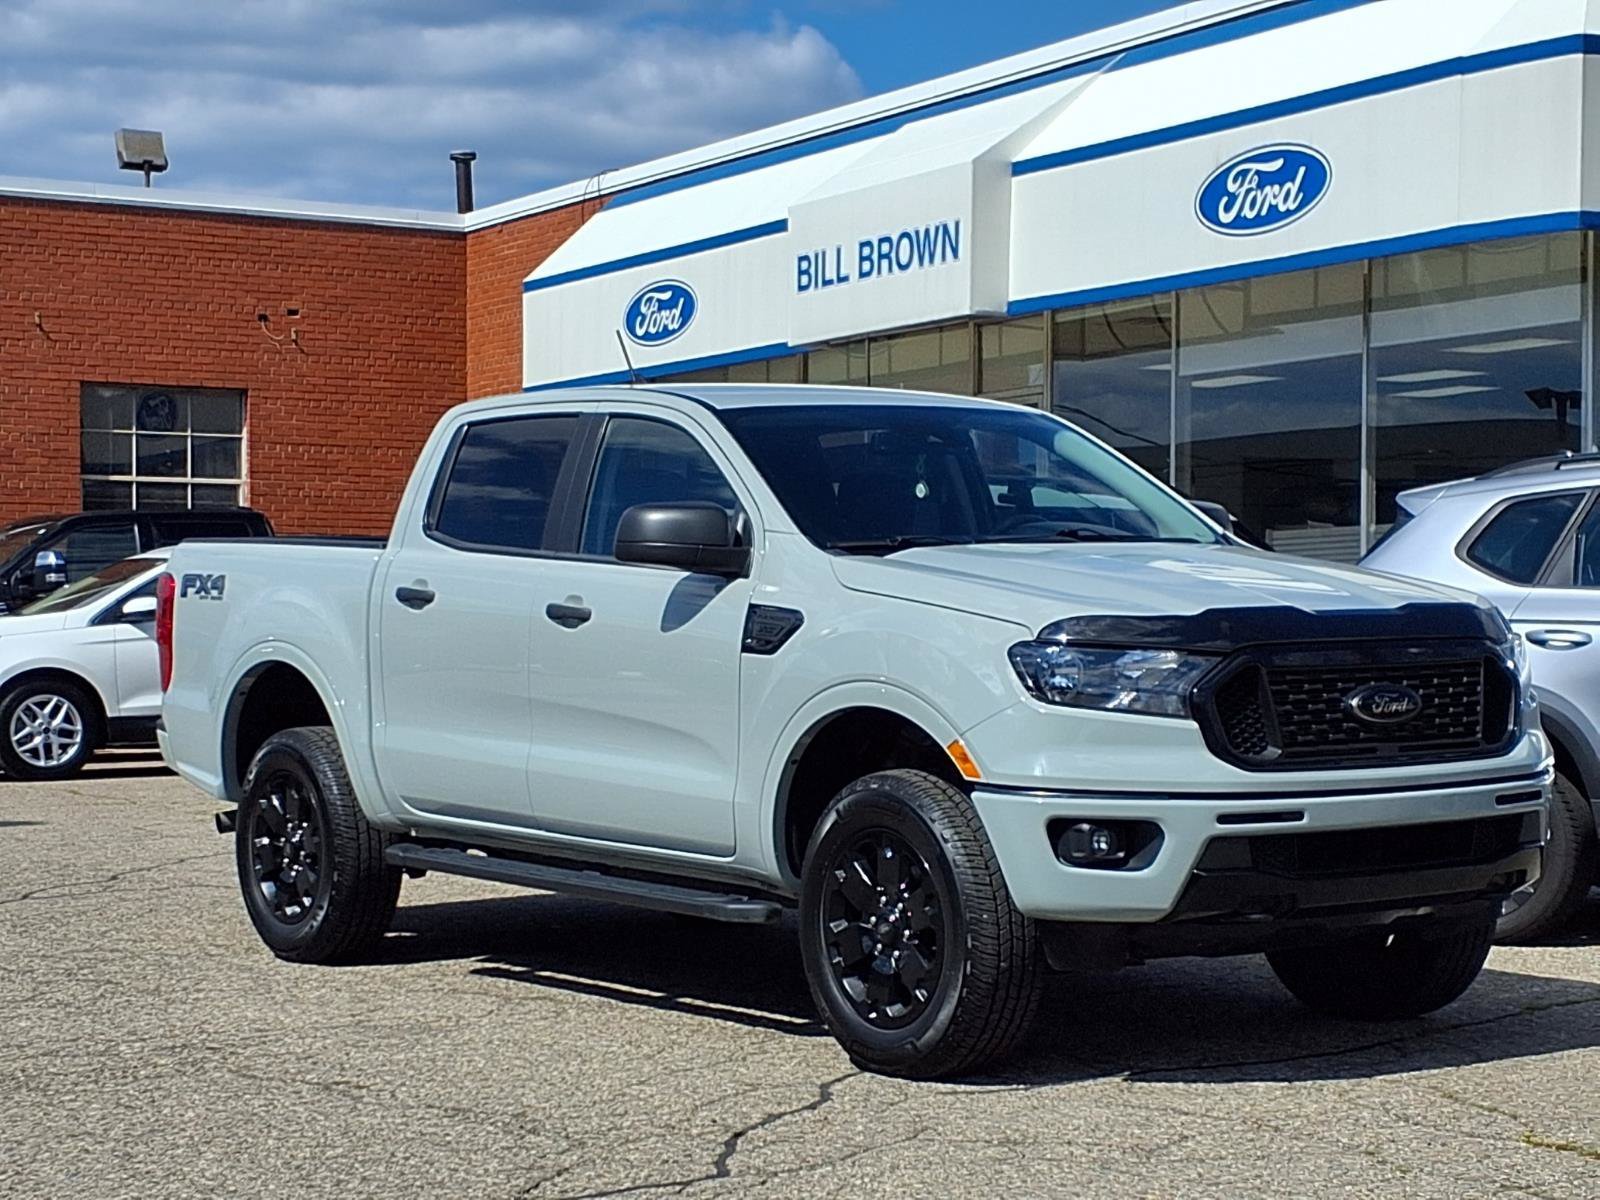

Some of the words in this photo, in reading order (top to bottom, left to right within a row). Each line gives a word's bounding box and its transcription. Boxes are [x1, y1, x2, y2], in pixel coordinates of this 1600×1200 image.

[1217, 157, 1306, 224] Ford
[797, 246, 850, 293] BILL
[858, 219, 961, 280] BROWN
[635, 290, 684, 337] Ford
[180, 573, 226, 598] FX4
[1371, 692, 1409, 714] Ford
